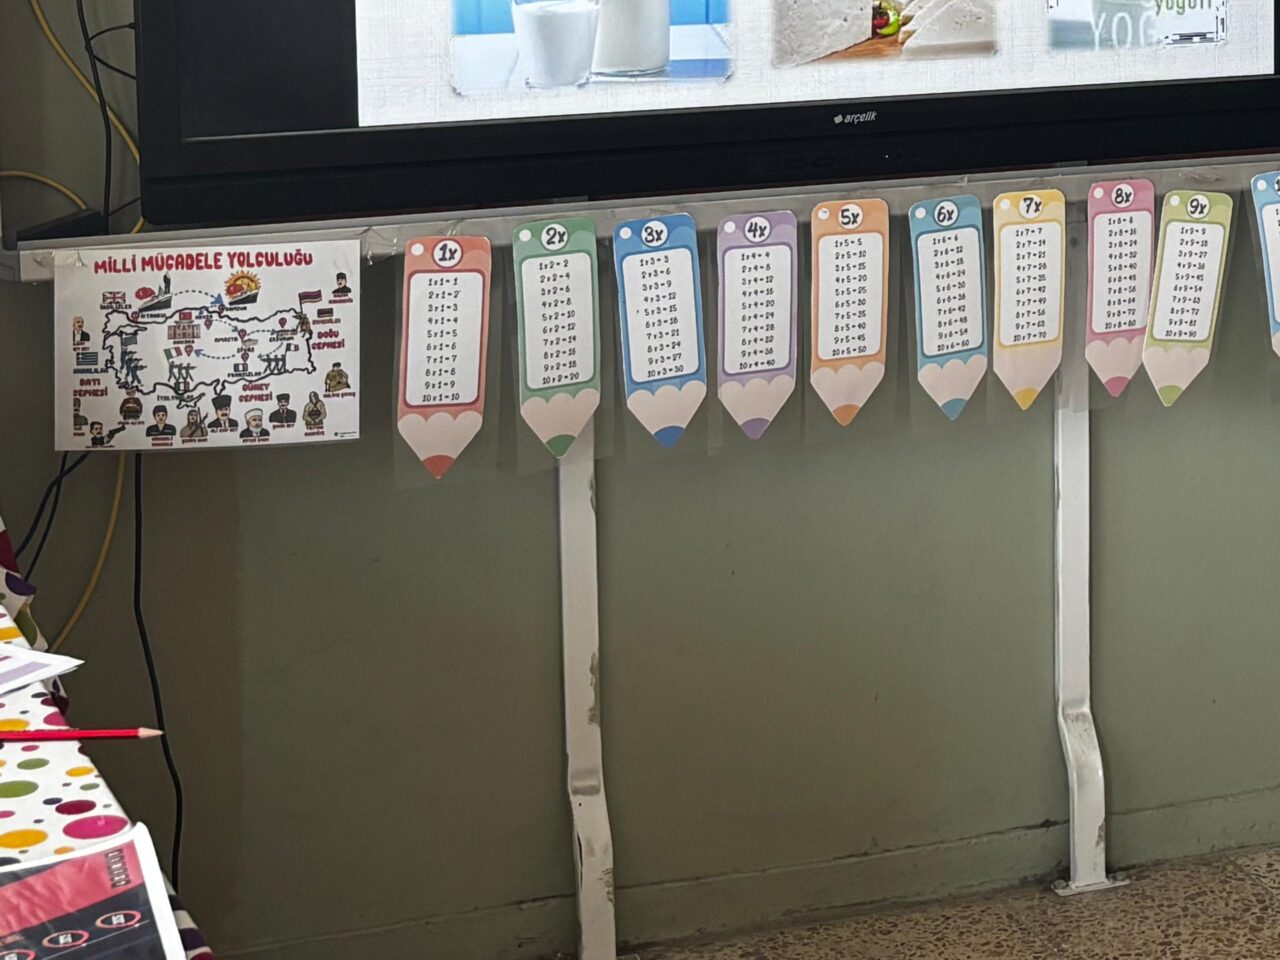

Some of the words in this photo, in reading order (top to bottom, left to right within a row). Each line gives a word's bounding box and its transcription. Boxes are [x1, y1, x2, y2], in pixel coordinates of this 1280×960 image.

[844, 111, 878, 125] arçelik
[1023, 196, 1042, 214] 7x
[1115, 186, 1133, 205] 8x
[938, 203, 955, 222] 6x
[1188, 197, 1207, 216] 9x
[840, 208, 860, 226] 5x
[545, 226, 566, 245] 2x
[644, 225, 664, 244] 3x
[747, 220, 767, 239] 4x
[94, 255, 136, 274] MİLLİ
[141, 252, 223, 272] MÜCADELE
[227, 248, 313, 269] YOLCULUĞU
[438, 243, 457, 262] 1x
[317, 329, 339, 338] DOĞU
